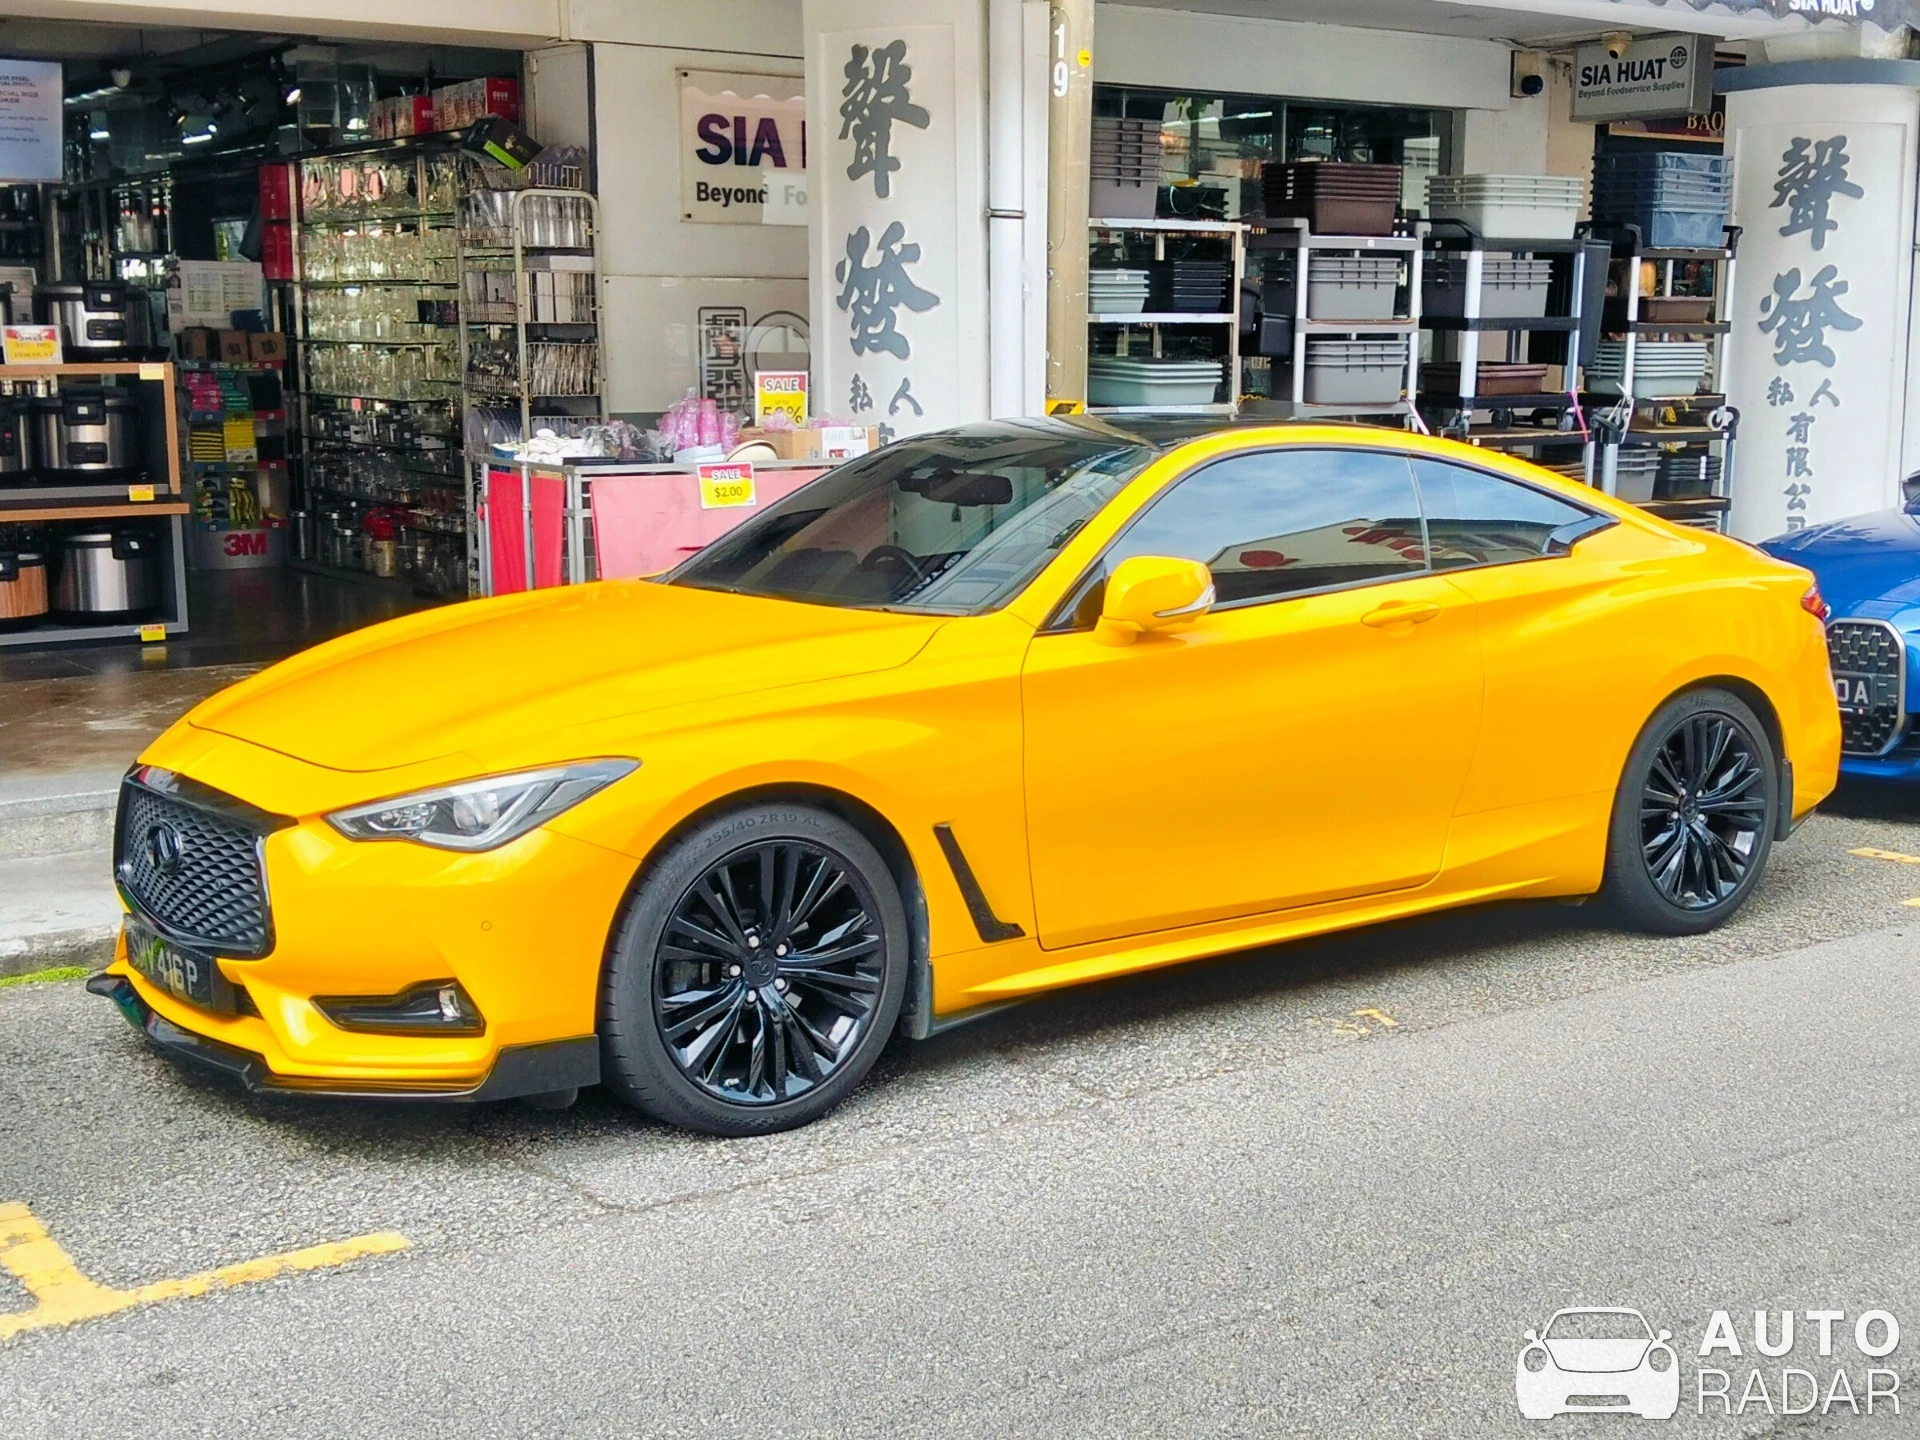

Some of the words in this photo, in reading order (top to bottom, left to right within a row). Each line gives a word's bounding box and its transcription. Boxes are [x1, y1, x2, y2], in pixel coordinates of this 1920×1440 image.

[1580, 64, 1611, 87] SIA
[1617, 58, 1667, 82] HUAT
[1578, 89, 1605, 99] Beyond
[1607, 84, 1650, 96] Foodservice
[1652, 81, 1685, 92] Supplies
[695, 113, 787, 168] SIA
[696, 181, 769, 207] Beyond
[765, 379, 798, 391] SALE
[713, 470, 740, 480] SALE
[714, 486, 743, 498] $2.00
[223, 532, 269, 556] 3M
[704, 817, 755, 849] 255/40
[760, 813, 779, 825] ZR
[782, 813, 798, 823] 19
[802, 816, 821, 827] XL
